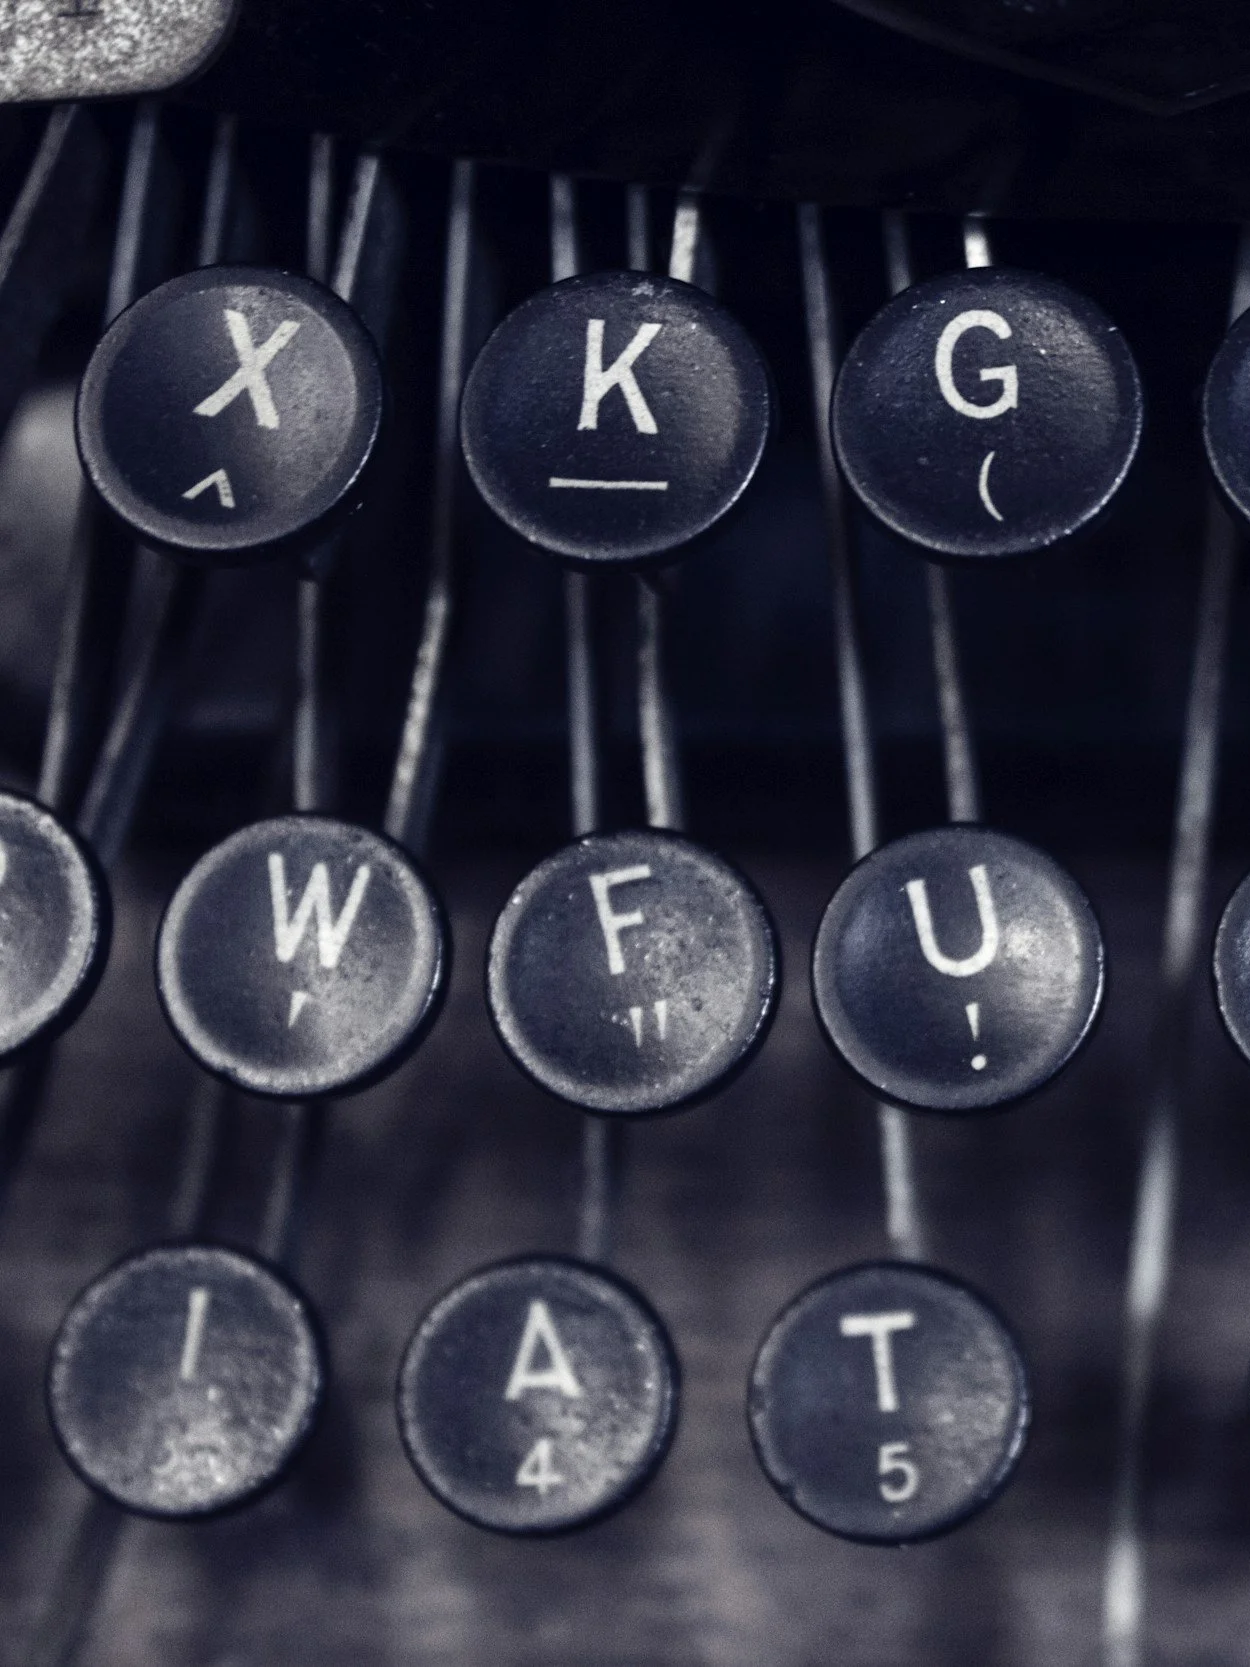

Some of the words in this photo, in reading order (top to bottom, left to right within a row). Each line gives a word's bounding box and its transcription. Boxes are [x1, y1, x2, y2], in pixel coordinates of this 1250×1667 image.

[193, 310, 301, 428] X
[576, 319, 662, 434] K
[935, 310, 1018, 418] G
[979, 450, 1004, 521] (
[268, 853, 371, 968] W
[590, 865, 651, 975] F
[907, 864, 999, 978] U
[965, 1003, 987, 1070] !
[506, 1300, 585, 1400] A
[840, 1312, 916, 1413] T
[516, 1439, 561, 1494] 4
[878, 1443, 919, 1502] 5
